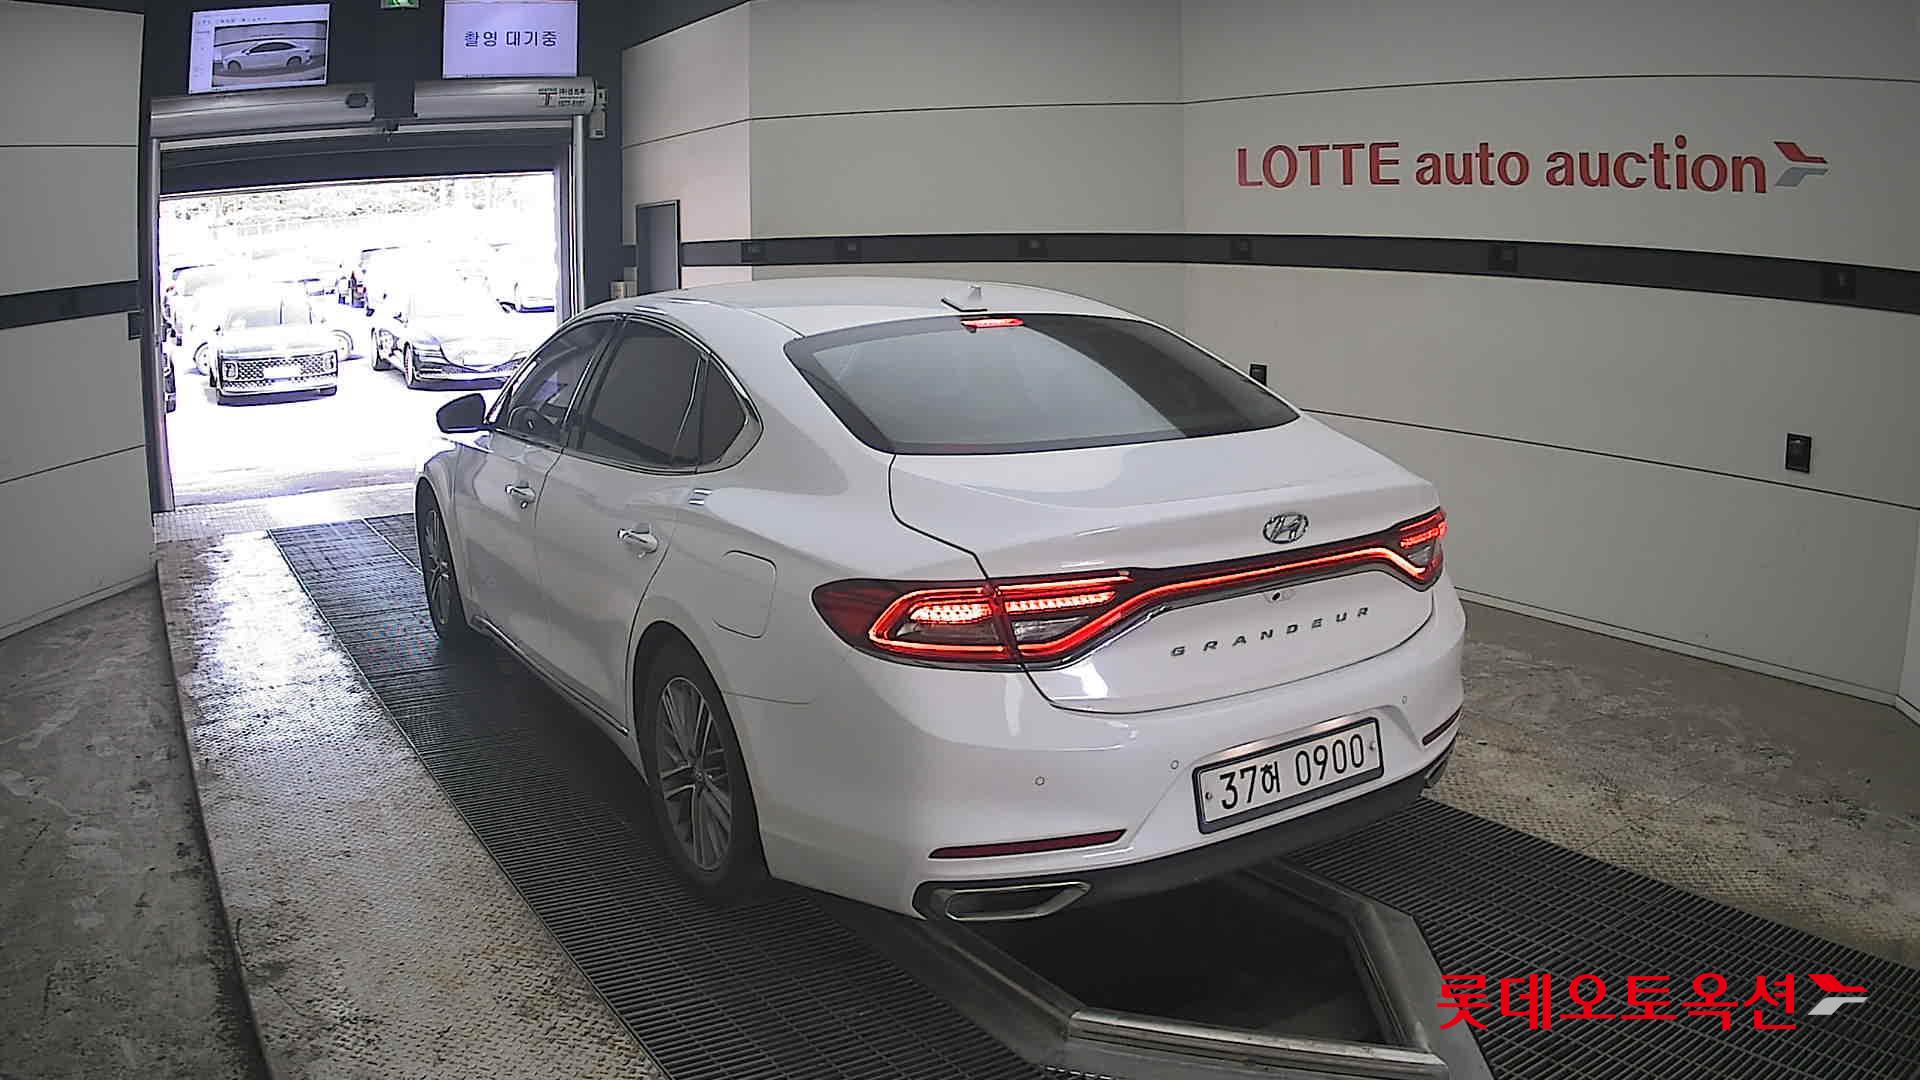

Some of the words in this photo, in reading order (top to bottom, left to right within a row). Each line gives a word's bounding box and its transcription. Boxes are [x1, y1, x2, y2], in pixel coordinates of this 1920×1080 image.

[464, 30, 498, 48] 촬영
[506, 30, 558, 48] 대기중
[1236, 142, 1400, 189] LOTTE
[1415, 142, 1530, 186] auto
[1545, 134, 1767, 194] auction
[1170, 607, 1369, 657] GRANDEUR
[1219, 760, 1281, 810] 37허
[1295, 734, 1365, 786] 0900
